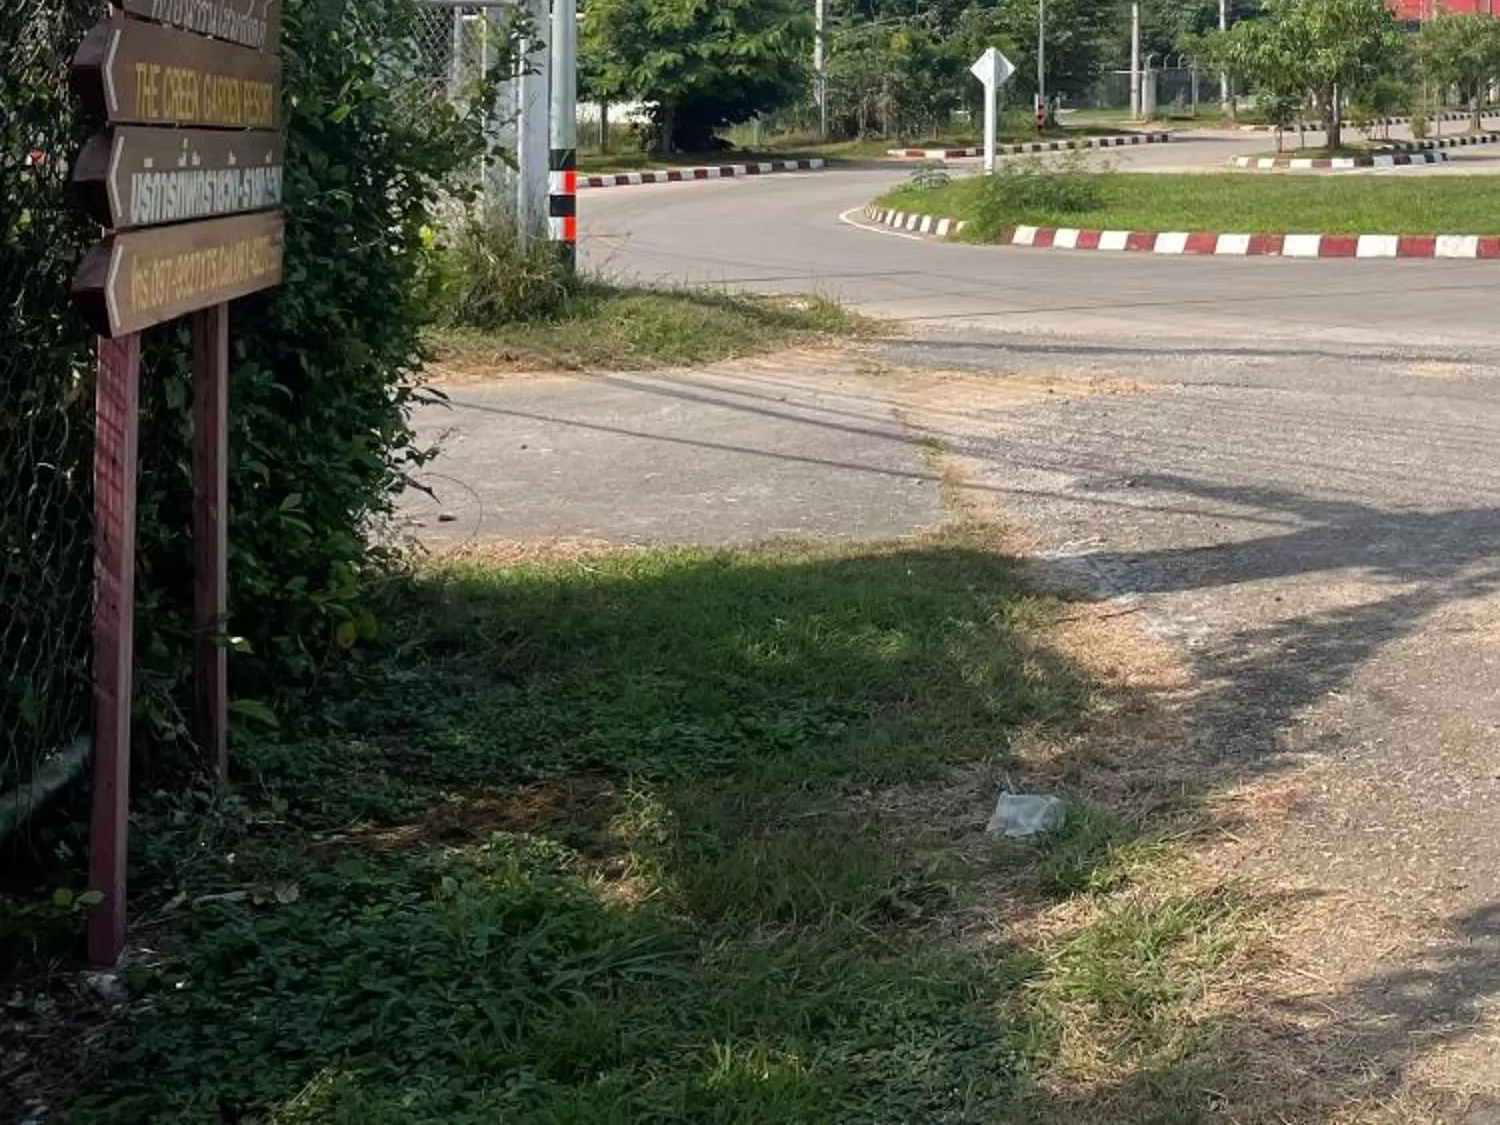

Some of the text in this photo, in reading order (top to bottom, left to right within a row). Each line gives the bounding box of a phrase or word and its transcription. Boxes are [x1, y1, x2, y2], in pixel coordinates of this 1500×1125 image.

[135, 61, 161, 120] THE
[163, 65, 199, 122] GREEN
[203, 71, 241, 125] GARDEN
